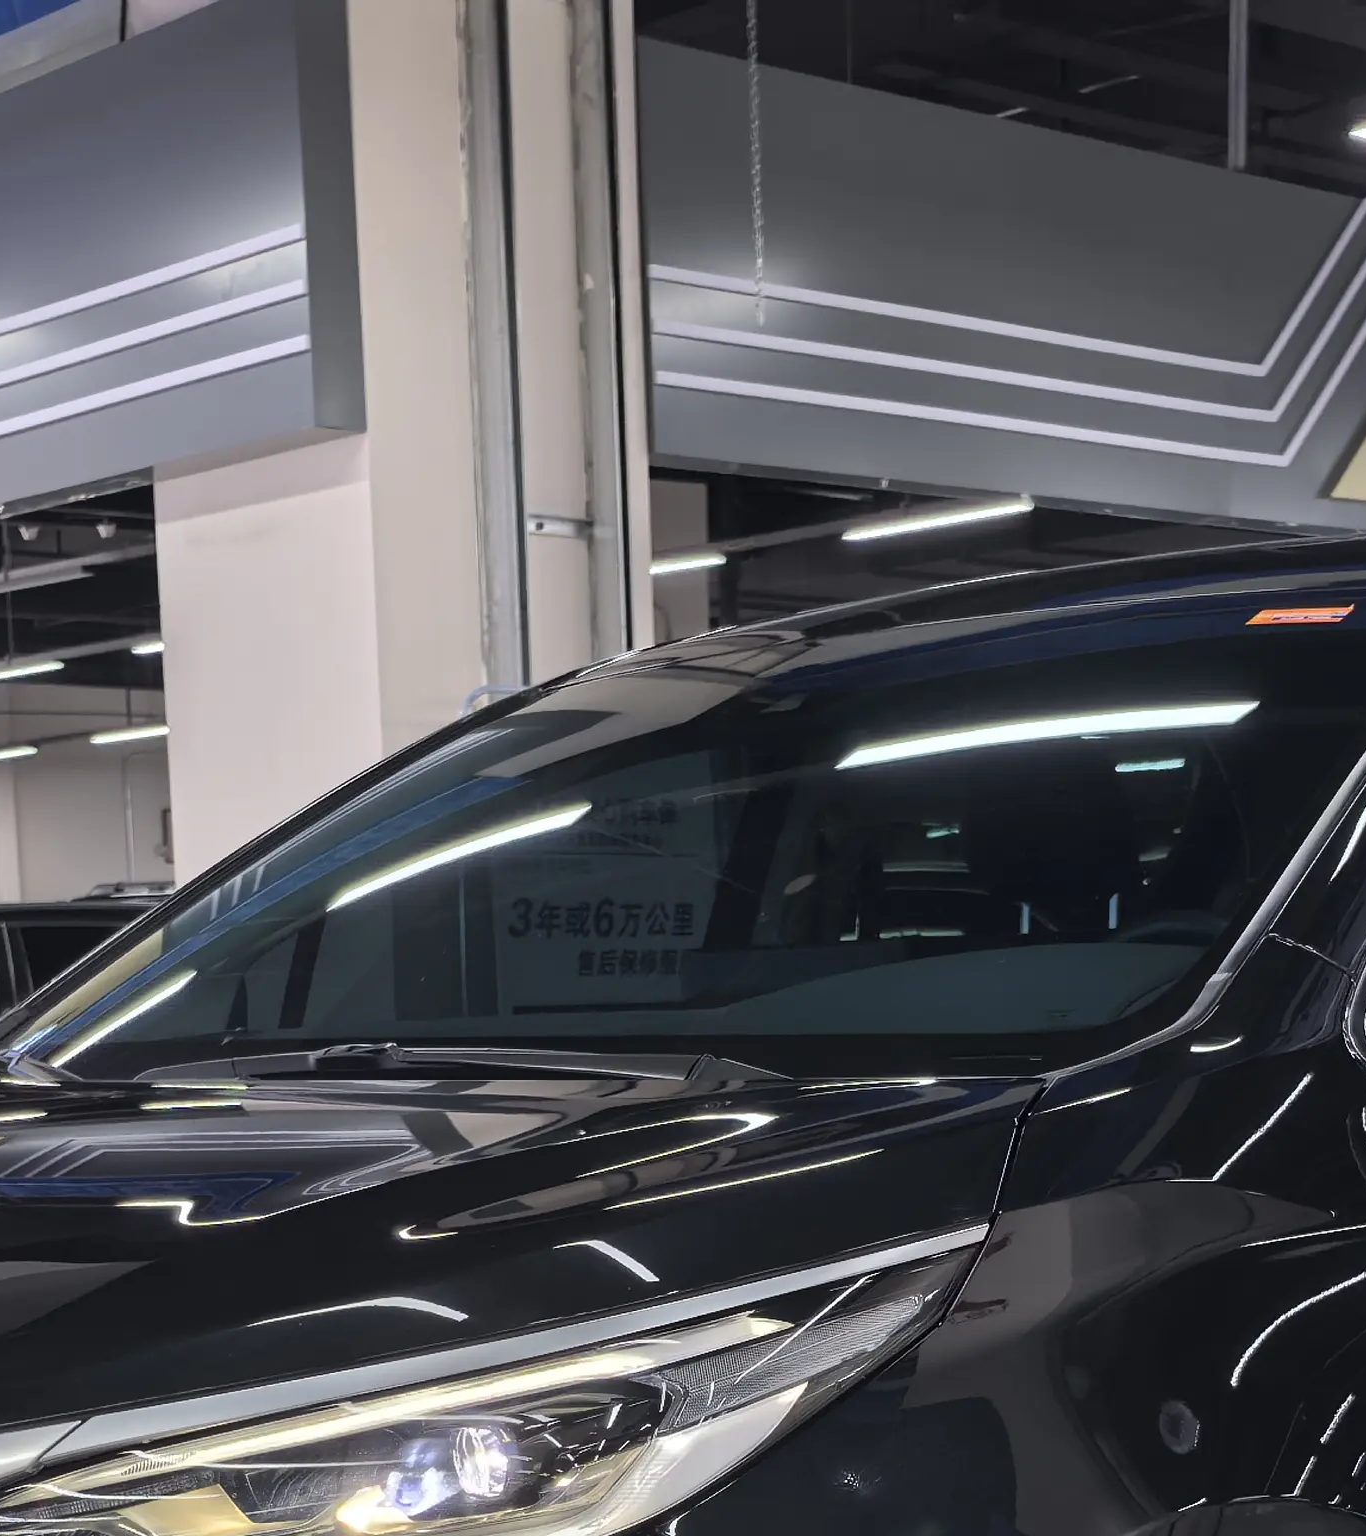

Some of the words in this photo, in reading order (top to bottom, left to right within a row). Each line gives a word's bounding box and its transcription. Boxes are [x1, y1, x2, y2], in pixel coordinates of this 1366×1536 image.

[508, 898, 695, 938] 3年或6万公里
